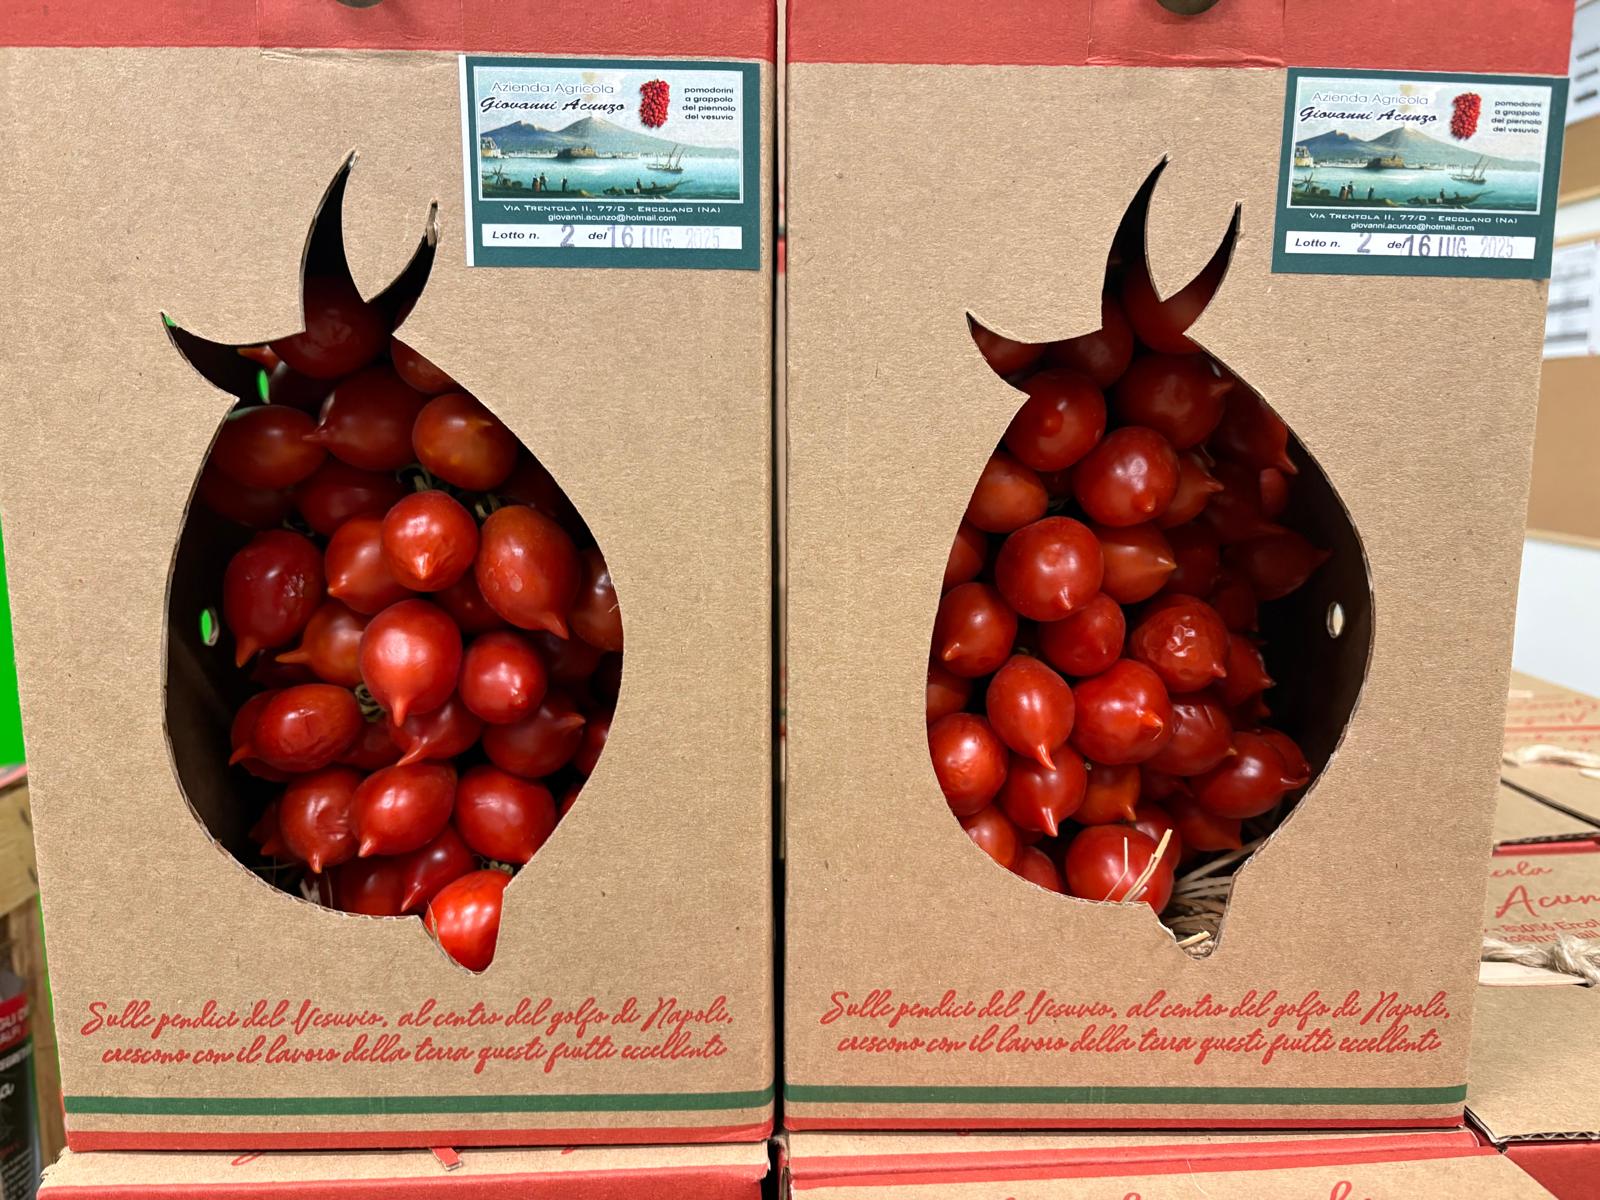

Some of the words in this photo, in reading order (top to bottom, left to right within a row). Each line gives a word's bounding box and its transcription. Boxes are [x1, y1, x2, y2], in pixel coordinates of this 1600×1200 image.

[492, 82, 550, 93] Azienda
[554, 83, 614, 95] Agricola
[684, 86, 734, 94] pomodorini
[480, 96, 557, 112] Giovanni
[561, 98, 625, 114] Acunzo
[1312, 92, 1368, 103] Azienda
[1372, 94, 1429, 105] Agricola
[1300, 106, 1373, 121] Giovanni
[1376, 109, 1437, 125] Acunzo
[548, 213, 677, 222] giovanni.acunzo@hotmail.com
[1350, 222, 1475, 231] giovanni.acunzo@hotmail.com
[492, 231, 525, 240] Lotto
[528, 232, 540, 240] n.
[560, 224, 575, 247] 2
[588, 231, 608, 240] del
[607, 225, 634, 248] 16
[685, 227, 720, 249] 2025
[1295, 238, 1327, 247] Lotto
[1330, 240, 1341, 248] n.
[1357, 232, 1372, 253] 2
[1387, 240, 1406, 249] del
[1404, 235, 1431, 257] 16
[1480, 236, 1514, 258] 2025
[80, 999, 155, 1036] Sulle
[150, 999, 239, 1040] pendici
[242, 999, 285, 1029] del
[291, 998, 389, 1035] Vesuvio,
[397, 998, 436, 1028] al
[433, 1001, 501, 1027] centro
[505, 997, 552, 1026] del
[545, 997, 609, 1038] golfo
[611, 997, 641, 1025] di
[640, 995, 734, 1032] Napoli,
[819, 989, 894, 1024] Sulle
[888, 989, 976, 1028] pendici
[978, 989, 1025, 1018] del
[1024, 989, 1118, 1025] Vesuvio,
[1126, 989, 1166, 1018] al
[1159, 993, 1229, 1018] centro
[1229, 990, 1278, 1018] del
[1268, 990, 1331, 1031] golfo
[1332, 990, 1361, 1018] di
[1359, 990, 1450, 1026] Napoli,
[101, 1047, 190, 1064] crescono
[192, 1048, 233, 1065] con
[236, 1034, 267, 1064] il
[265, 1034, 340, 1064] lavoro
[342, 1033, 411, 1063] della
[414, 1036, 474, 1062] terra
[473, 1036, 548, 1074] questi
[544, 1034, 617, 1073] frutti
[621, 1031, 728, 1061] eccellenti
[837, 1034, 925, 1053] crescono
[926, 1037, 966, 1053] con
[968, 1024, 1000, 1052] il
[996, 1024, 1069, 1053] lavoro
[1069, 1024, 1136, 1053] della
[1139, 1027, 1197, 1053] terra
[1194, 1028, 1268, 1065] questi
[1262, 1028, 1335, 1065] frutti
[1339, 1025, 1442, 1053] eccellenti
